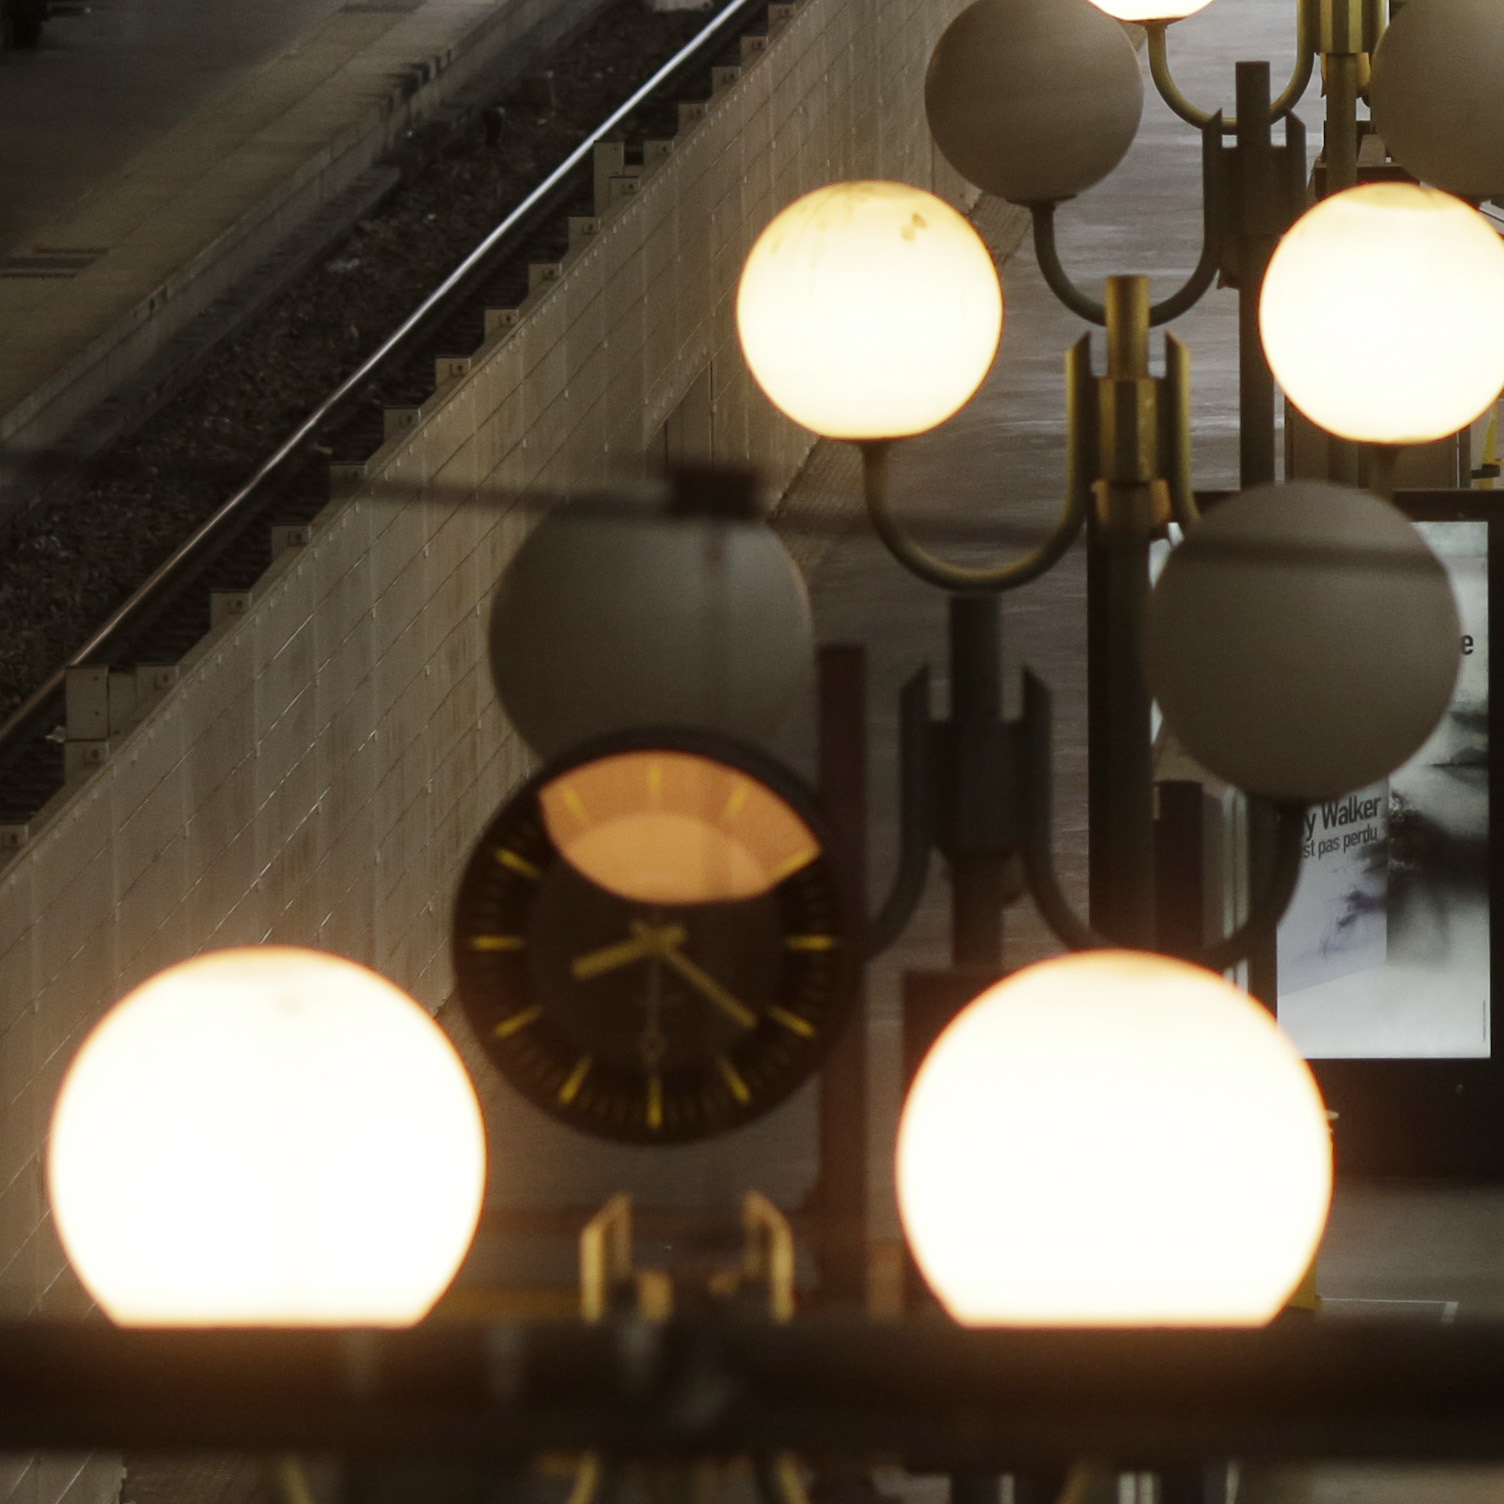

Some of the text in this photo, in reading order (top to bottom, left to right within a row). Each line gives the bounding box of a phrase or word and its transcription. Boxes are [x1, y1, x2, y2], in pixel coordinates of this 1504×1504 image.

[1321, 795, 1382, 830] Walker
[1318, 837, 1340, 860] pas
[1343, 823, 1378, 854] perdu
